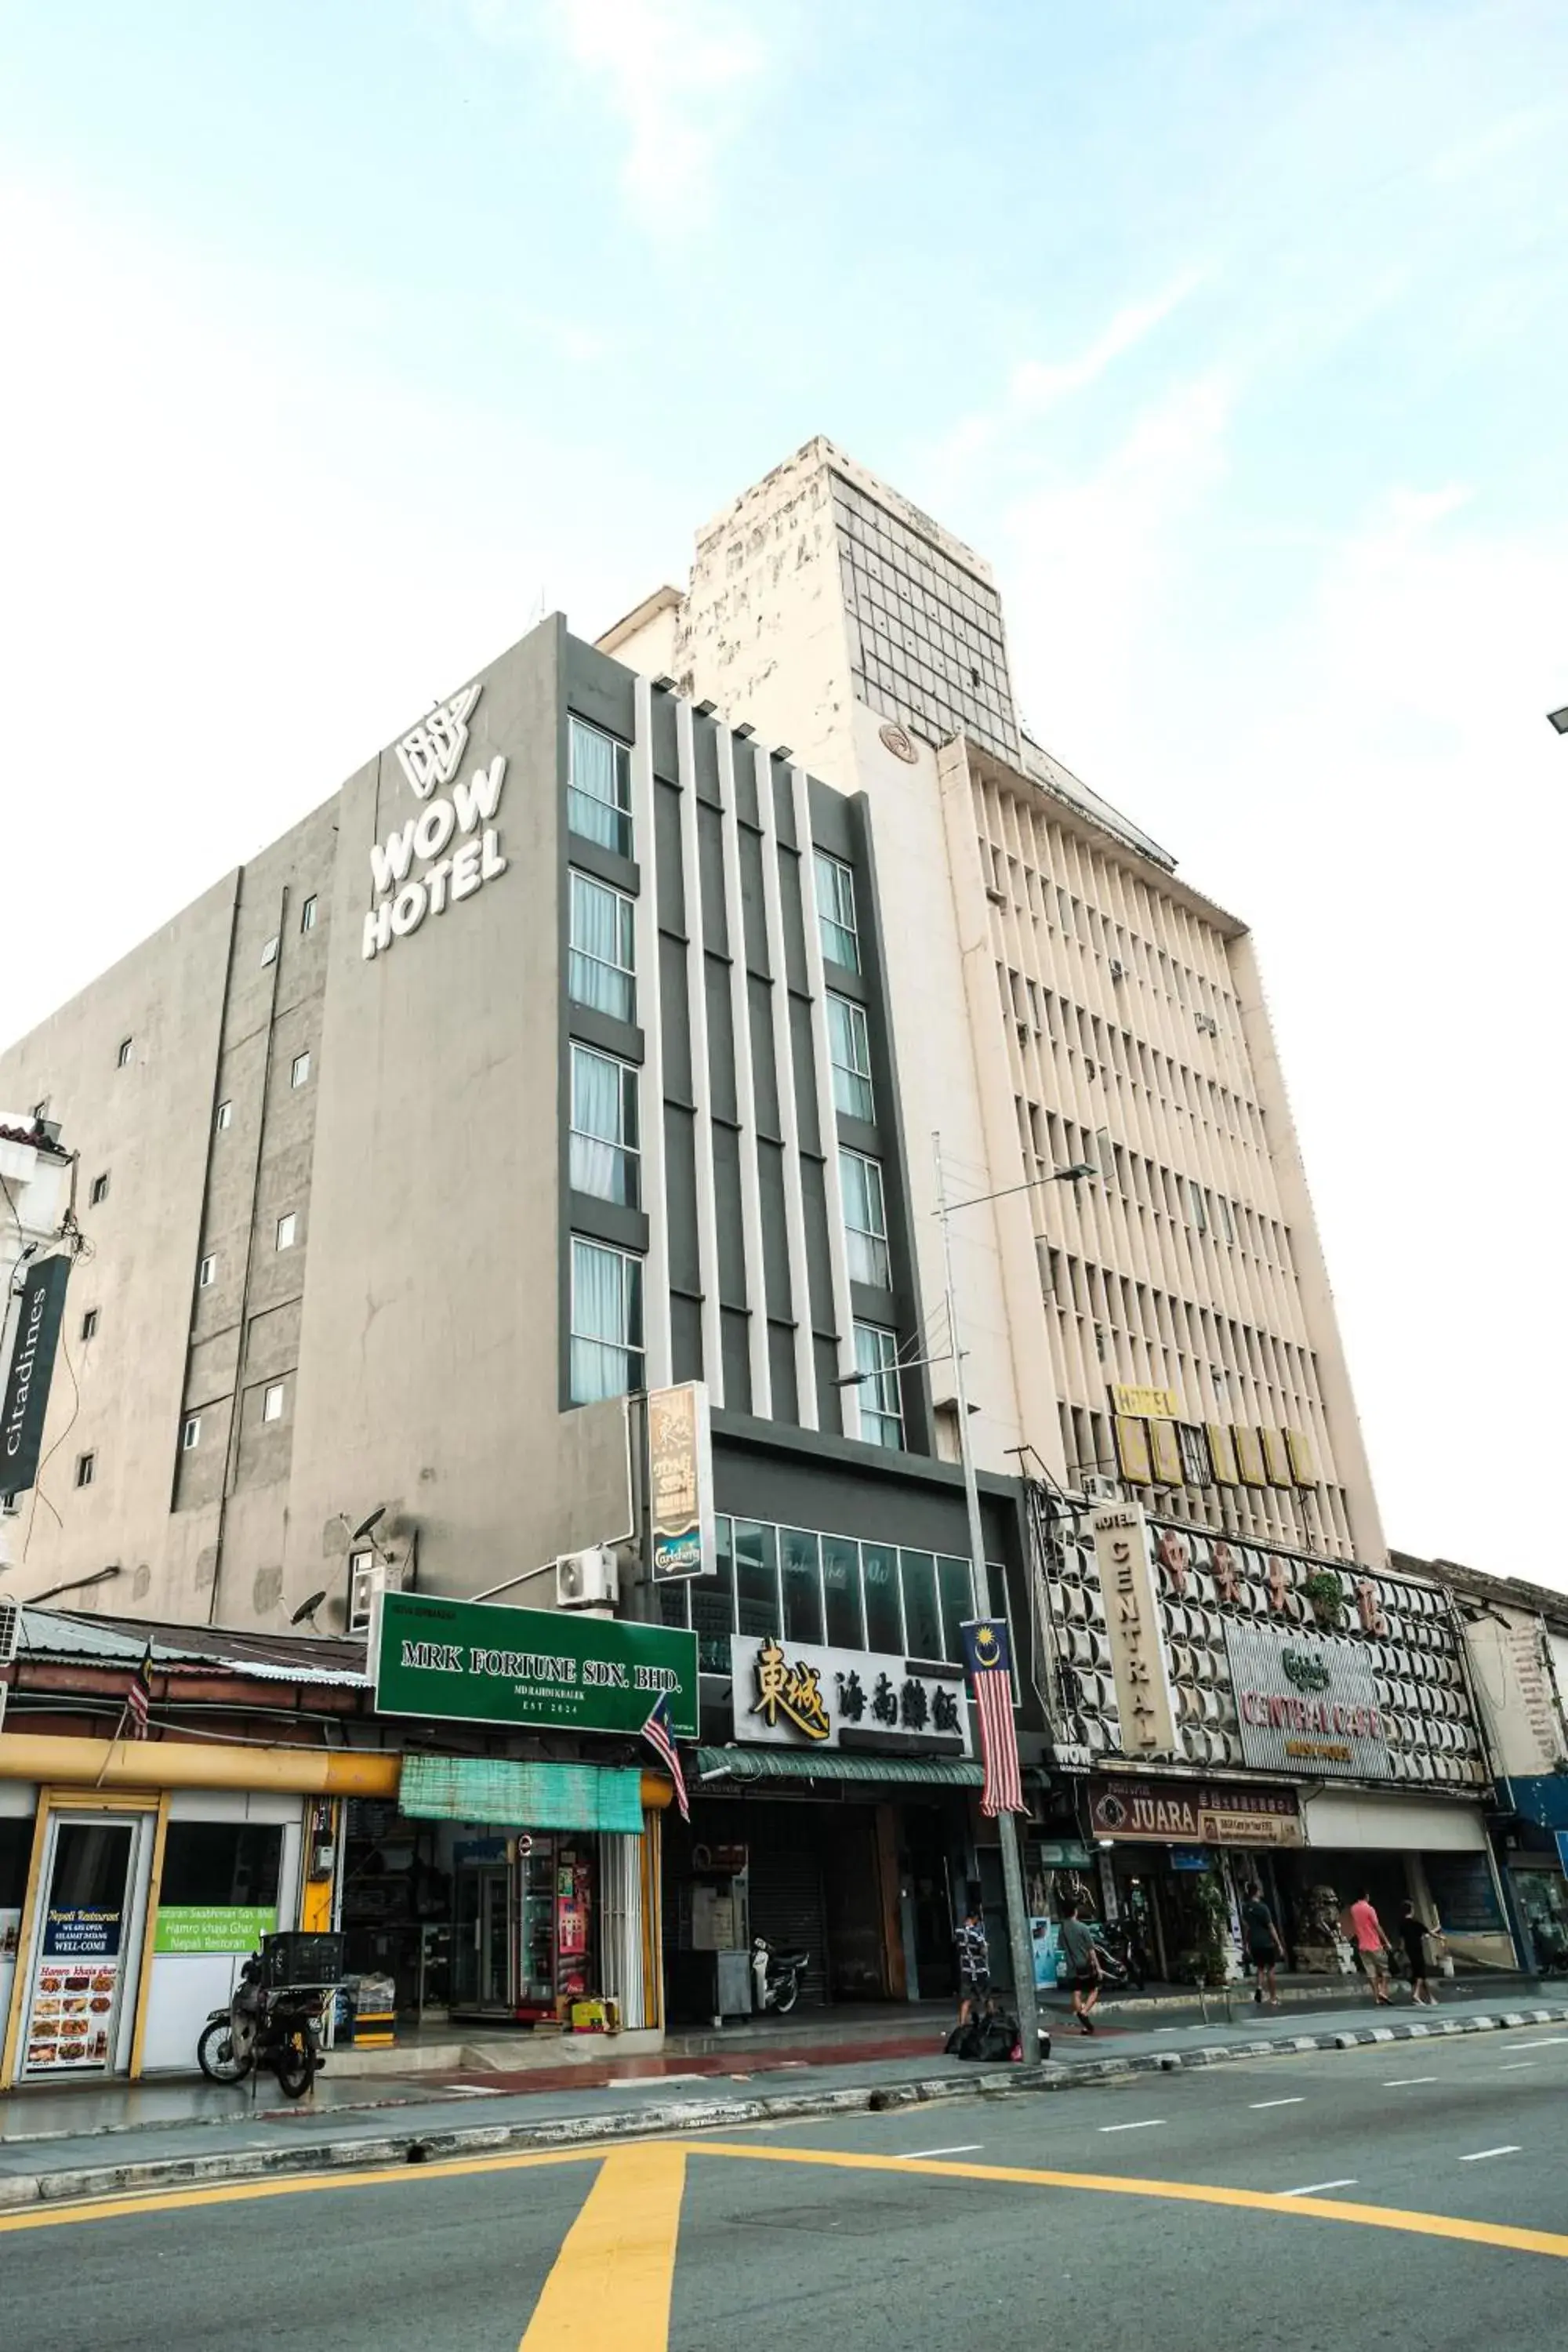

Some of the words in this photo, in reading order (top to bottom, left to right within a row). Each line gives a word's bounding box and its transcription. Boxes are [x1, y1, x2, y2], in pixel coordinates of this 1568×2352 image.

[370, 754, 506, 894] WOW
[362, 829, 507, 960] HOTEL
[8, 1287, 45, 1456] Citadines
[1094, 1513, 1138, 1531] HOTEL
[1111, 1541, 1157, 1748] CENTRAL
[401, 1640, 464, 1671] MRK
[470, 1649, 576, 1683] FORTUNE
[583, 1660, 630, 1688] SDN.
[634, 1665, 683, 1693] BHD.
[523, 1700, 543, 1711] EST
[1241, 1690, 1327, 1733] CENTRAL
[1053, 1744, 1091, 1766] WOW
[1131, 1798, 1196, 1832] JUARA
[165, 1922, 198, 1934] Hamro
[230, 1922, 255, 1934] Ghar.
[171, 1937, 201, 1951] Nepali
[205, 1937, 245, 1949] Restoran
[55, 1941, 106, 1951] WELL-COME
